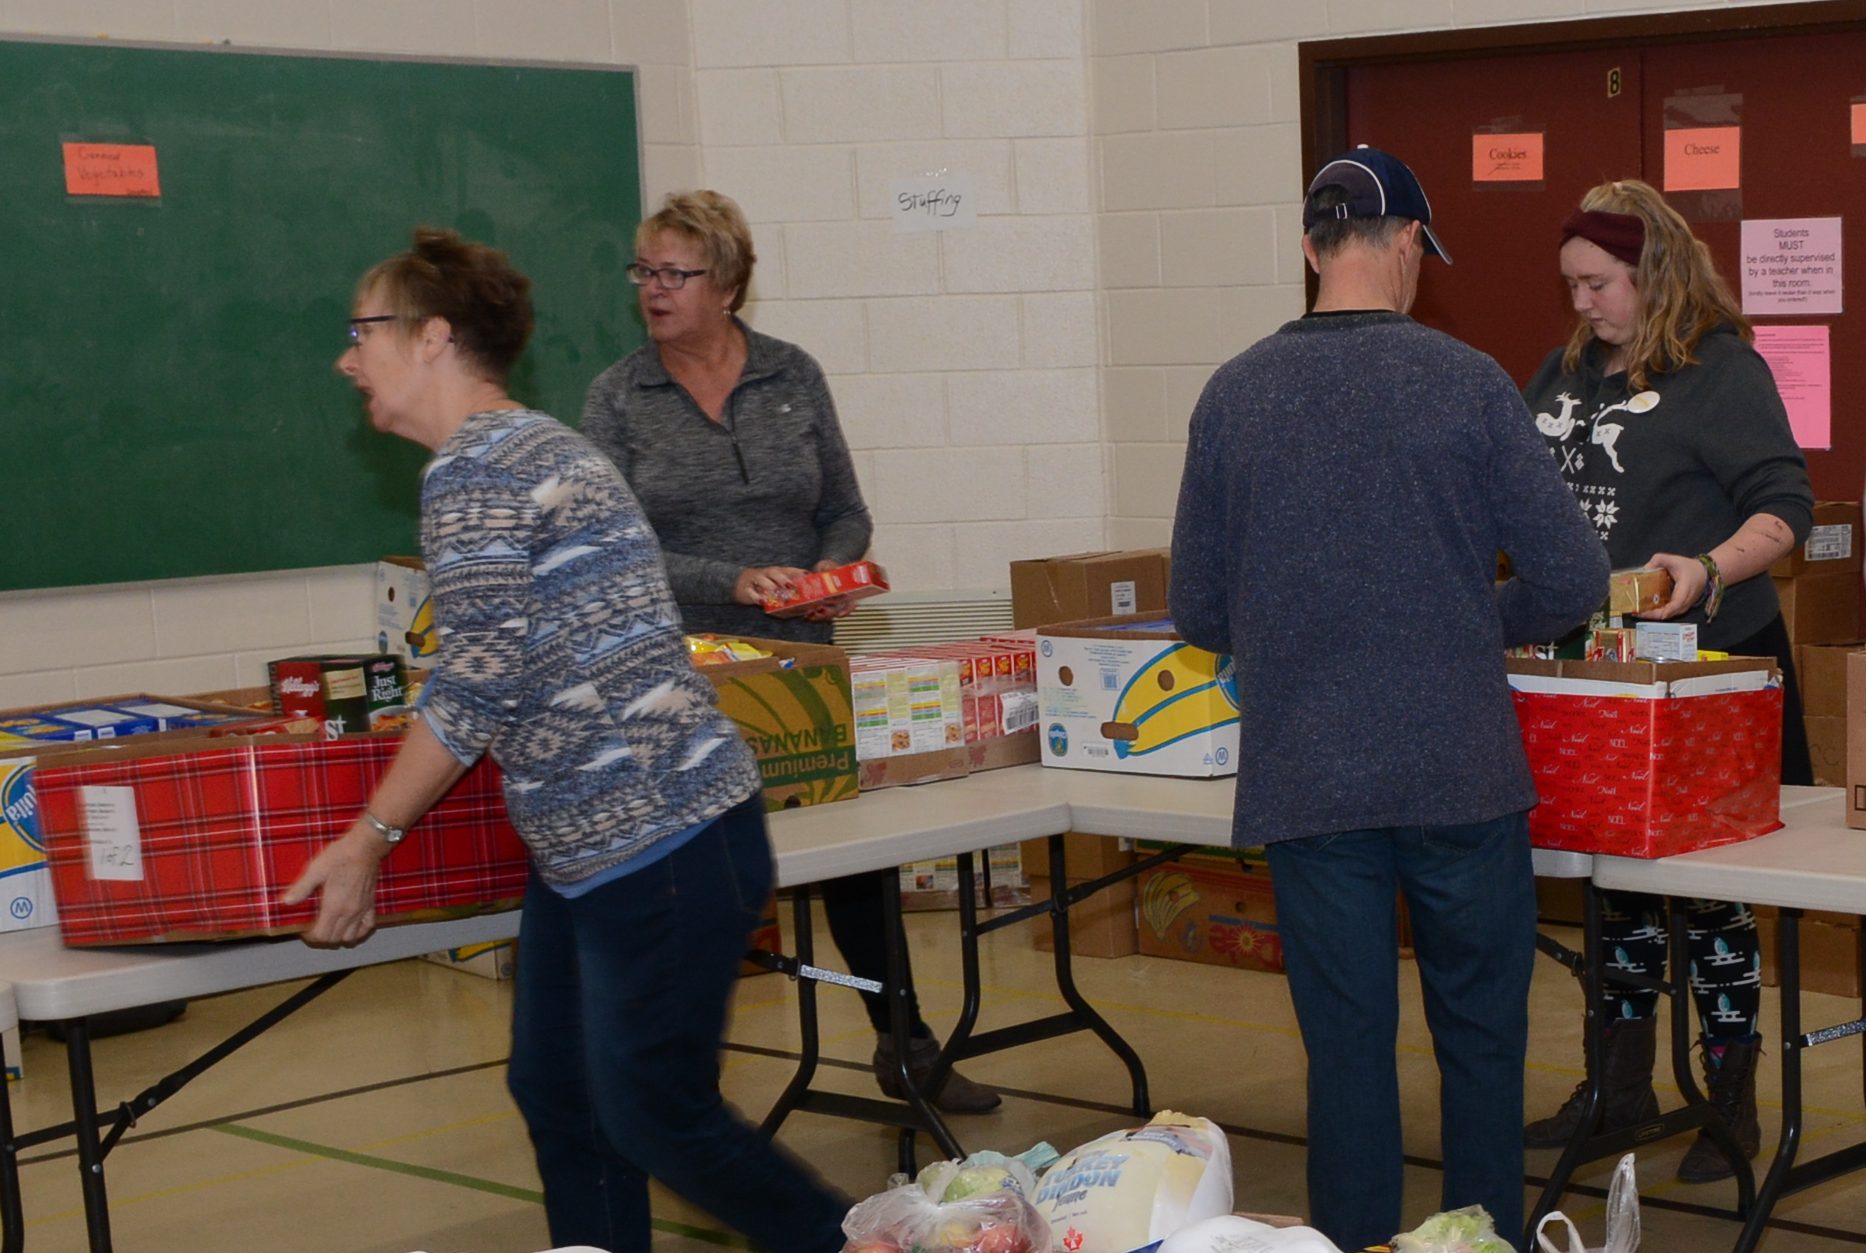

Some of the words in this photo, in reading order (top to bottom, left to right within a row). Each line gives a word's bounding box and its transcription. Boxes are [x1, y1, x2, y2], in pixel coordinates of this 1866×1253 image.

[1609, 70, 1620, 95] 8
[1489, 147, 1527, 161] Cookies
[1684, 142, 1720, 155] Cheese
[1774, 228, 1810, 239] Students
[1779, 240, 1805, 251] MUST
[1760, 254, 1789, 265] directly
[1790, 253, 1836, 265] supervised
[1769, 266, 1799, 275] teacher
[1801, 266, 1824, 275] when
[762, 752, 849, 778] Premium
